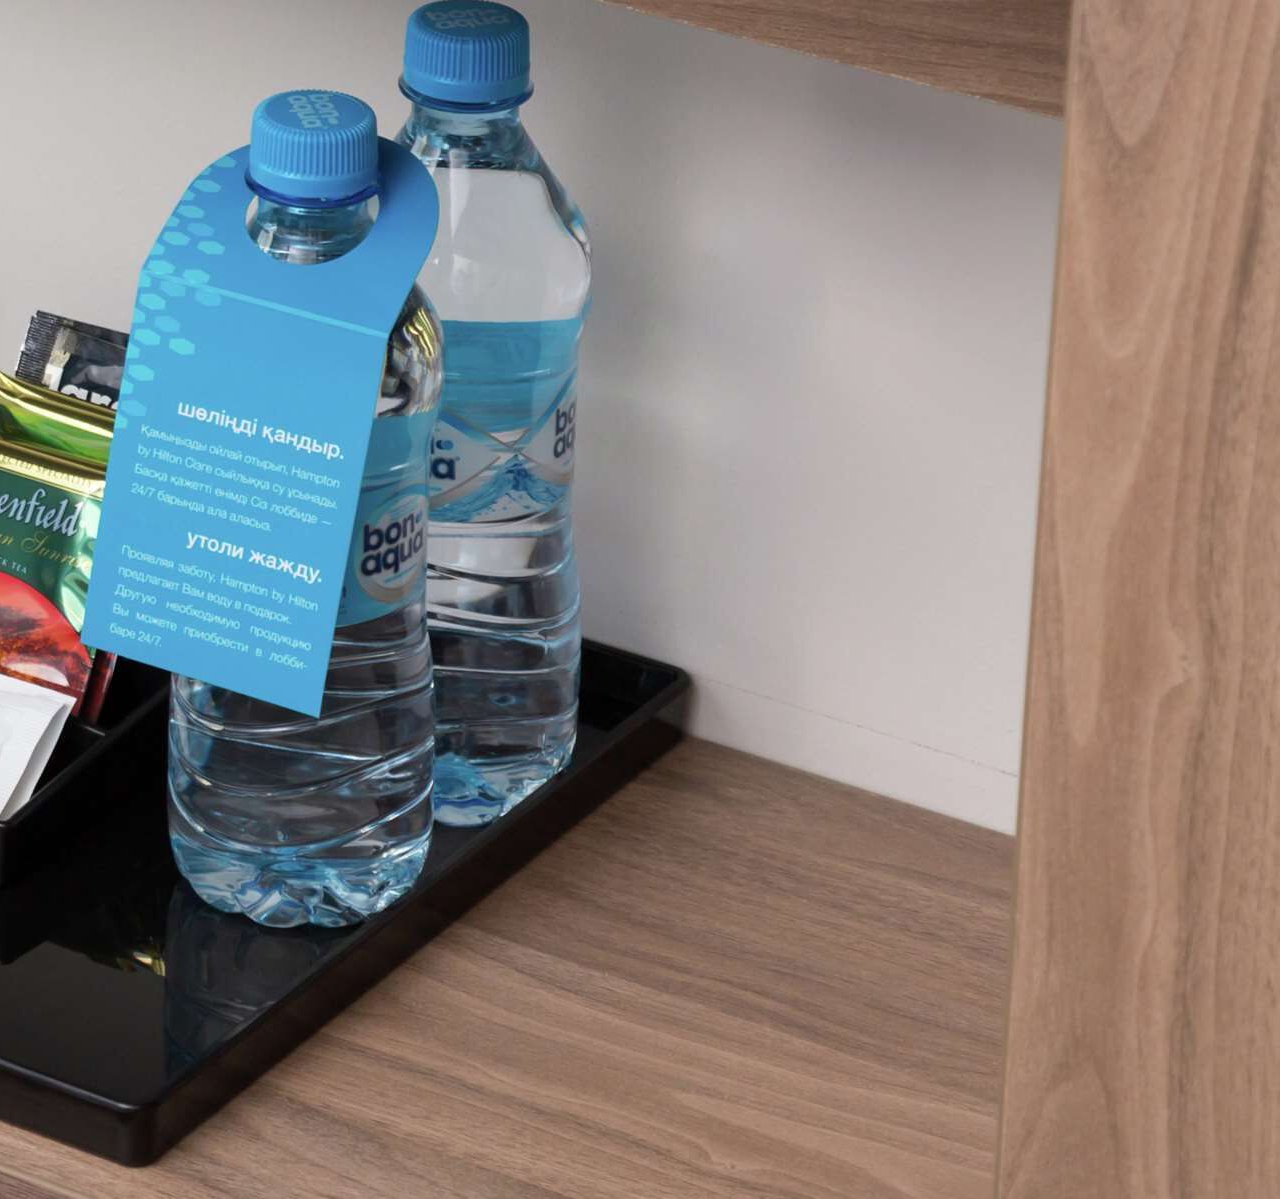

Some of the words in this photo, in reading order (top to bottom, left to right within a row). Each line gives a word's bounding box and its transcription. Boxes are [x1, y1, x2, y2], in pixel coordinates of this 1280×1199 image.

[177, 402, 257, 437] шөліңді
[262, 425, 344, 460] қандыр.
[137, 444, 151, 457] by
[153, 448, 183, 465] Hilton
[130, 483, 155, 497] 24/7
[291, 465, 340, 488] Hampton
[12, 562, 28, 574] TEA
[186, 531, 244, 560] утоли
[248, 549, 323, 585] жажду.
[360, 527, 424, 577] aqua
[118, 566, 179, 589] предлагает
[181, 582, 204, 598] Вам
[207, 592, 232, 610] воду
[234, 599, 242, 609] в
[121, 544, 174, 569] Проявляя
[220, 573, 269, 596] Hampton
[272, 588, 285, 604] by
[288, 594, 319, 612] Hilton
[114, 584, 158, 606] Другую
[109, 622, 136, 640] баре
[112, 604, 129, 617] Вы
[136, 611, 177, 631] можете
[255, 646, 263, 657] в
